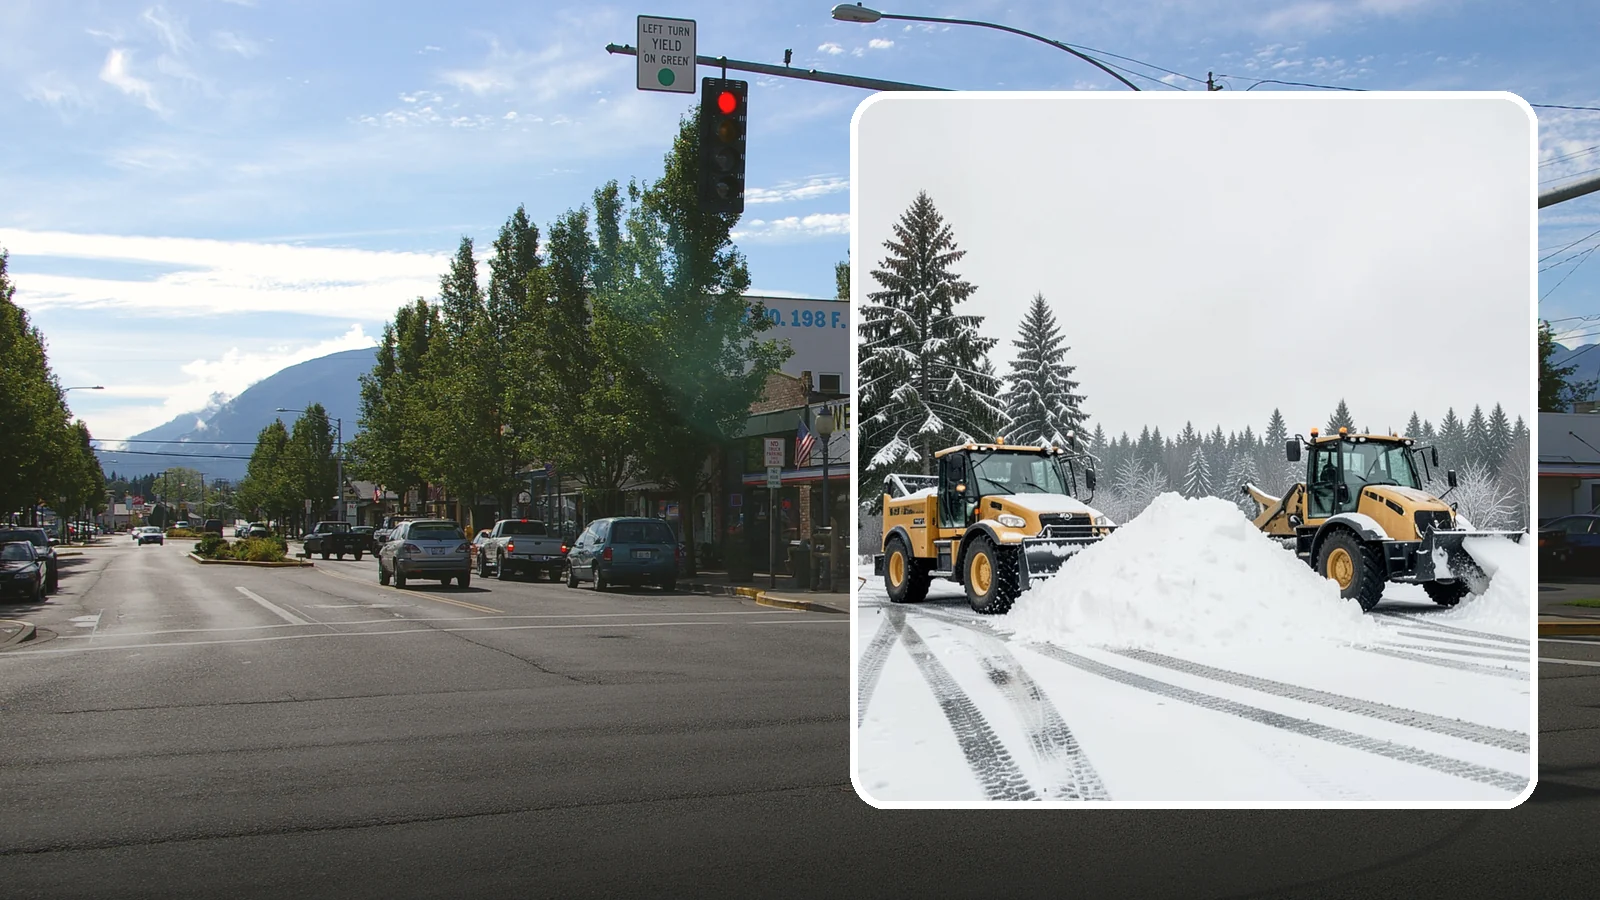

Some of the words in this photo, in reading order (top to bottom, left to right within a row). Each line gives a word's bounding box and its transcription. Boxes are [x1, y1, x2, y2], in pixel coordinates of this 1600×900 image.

[643, 23, 663, 34] LEFT
[668, 25, 690, 37] TURN
[652, 37, 682, 52] YIELD
[644, 53, 656, 64] ON
[660, 54, 689, 66] GREEN
[791, 309, 826, 328] 198
[831, 311, 846, 329] F.
